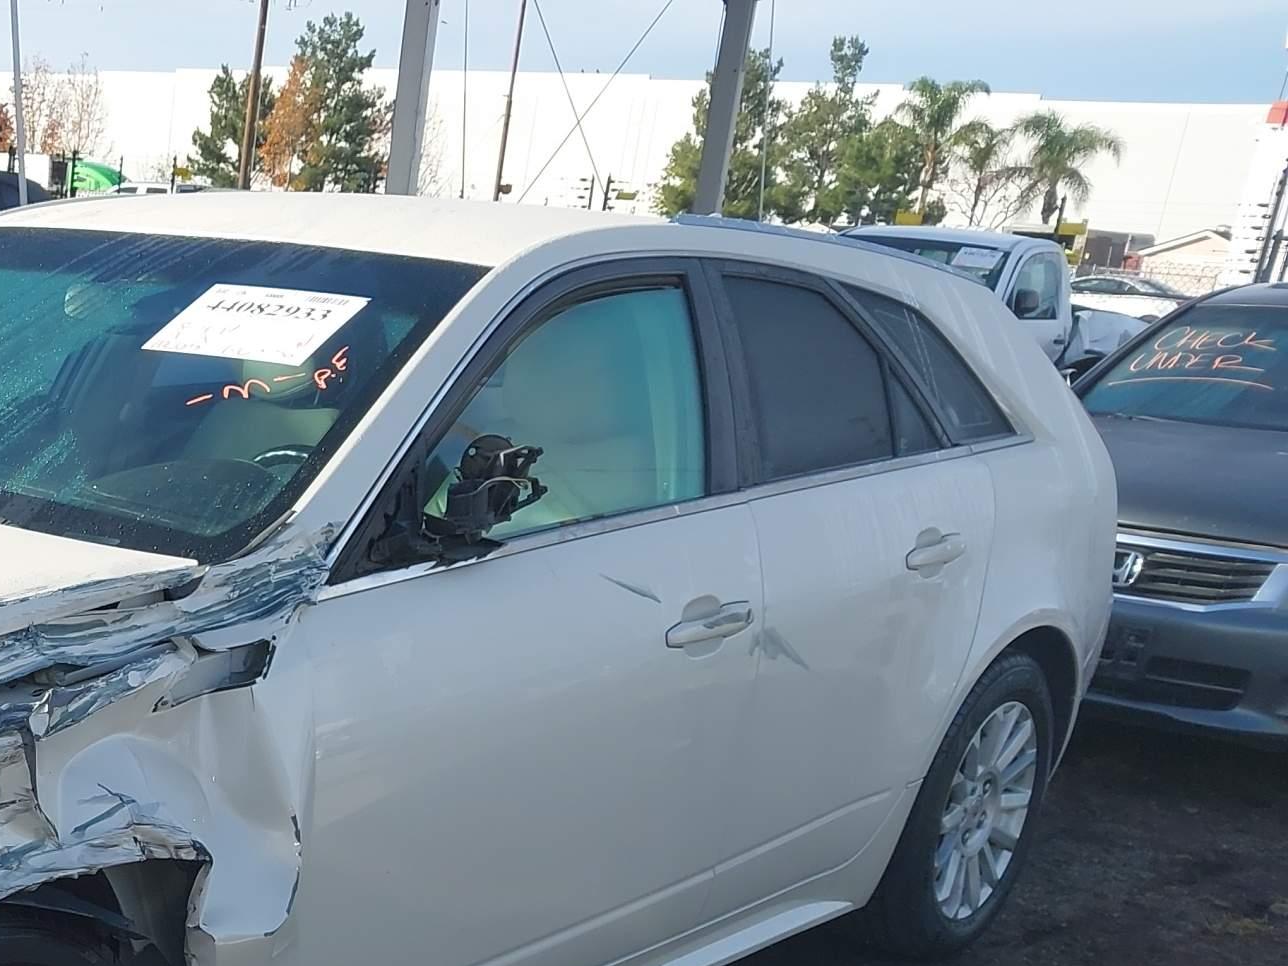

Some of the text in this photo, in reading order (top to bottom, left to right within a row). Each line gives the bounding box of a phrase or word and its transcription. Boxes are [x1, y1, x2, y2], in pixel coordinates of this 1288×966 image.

[207, 299, 332, 322] 44082933
[1154, 326, 1277, 351] CHECK
[1129, 351, 1265, 371] UNDER
